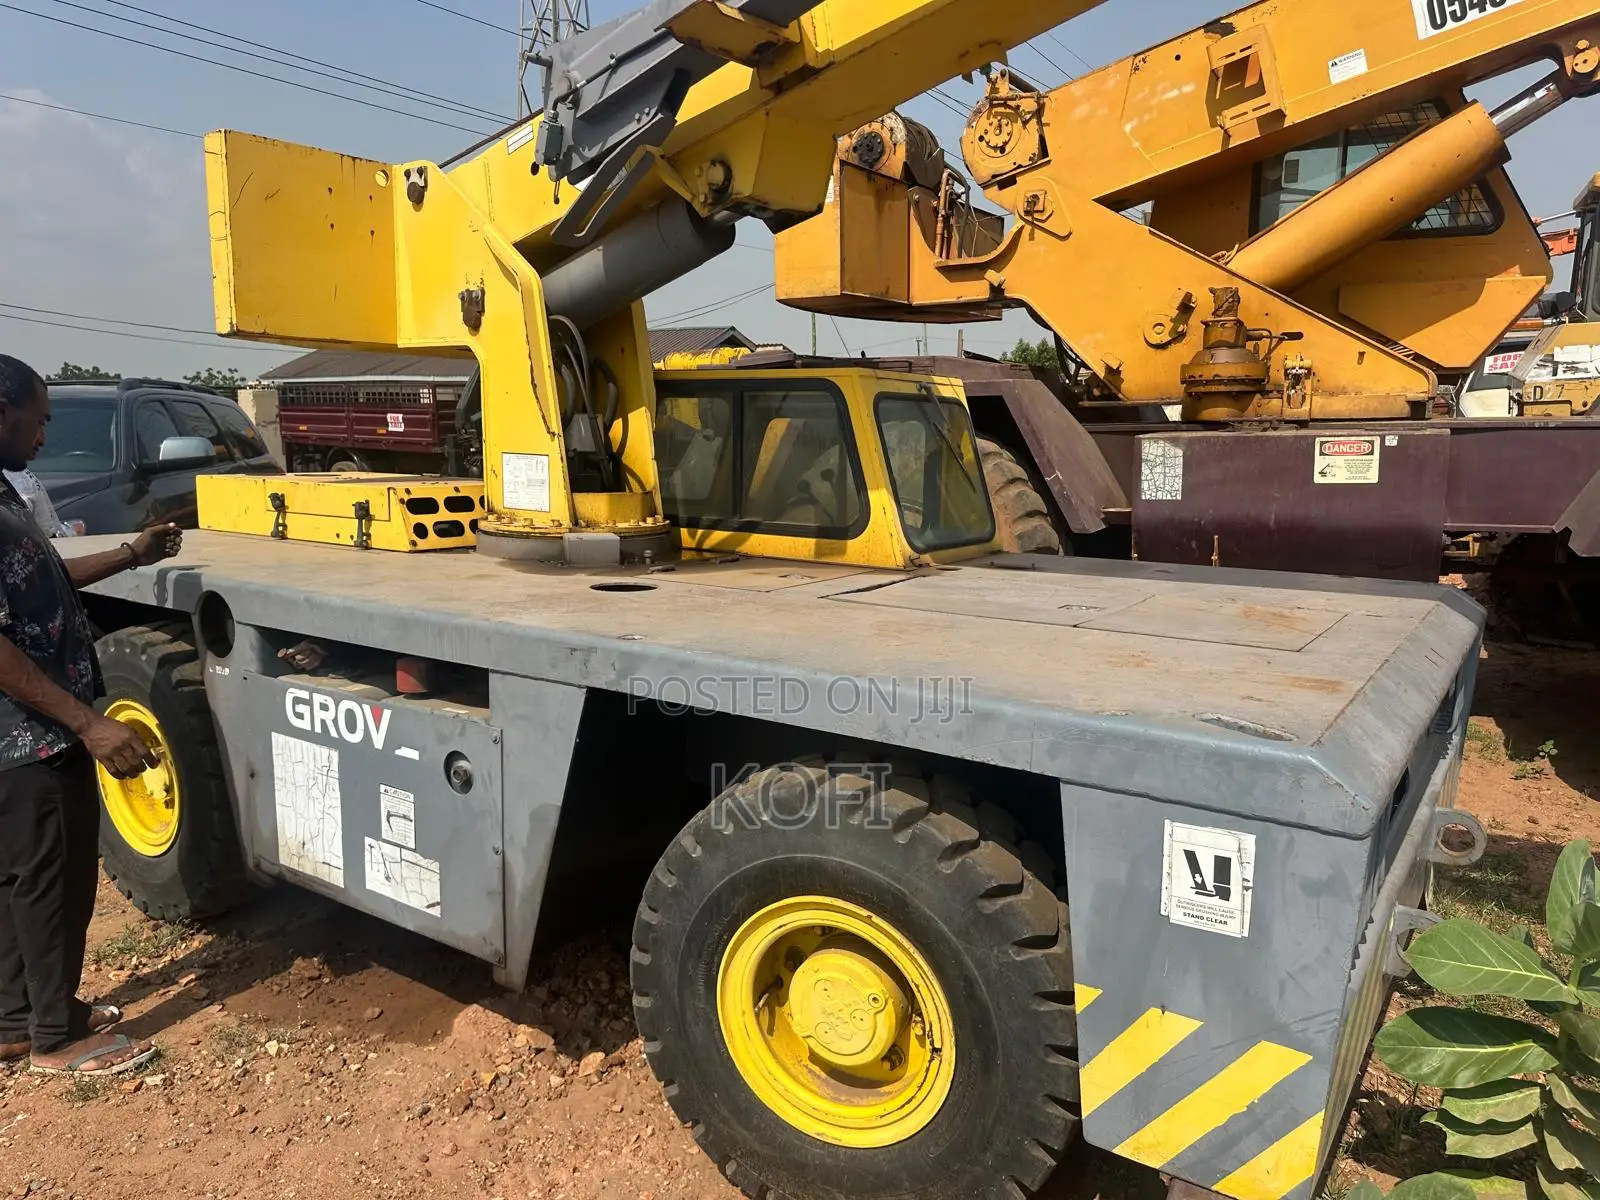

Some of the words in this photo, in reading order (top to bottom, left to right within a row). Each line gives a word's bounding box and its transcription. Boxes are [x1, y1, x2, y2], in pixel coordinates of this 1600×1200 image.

[1426, 0, 1508, 30] 05
[1325, 443, 1369, 453] DANGER
[285, 687, 420, 760] GROV
[1182, 912, 1204, 920] STAND
[1206, 917, 1228, 925] CLEAR
